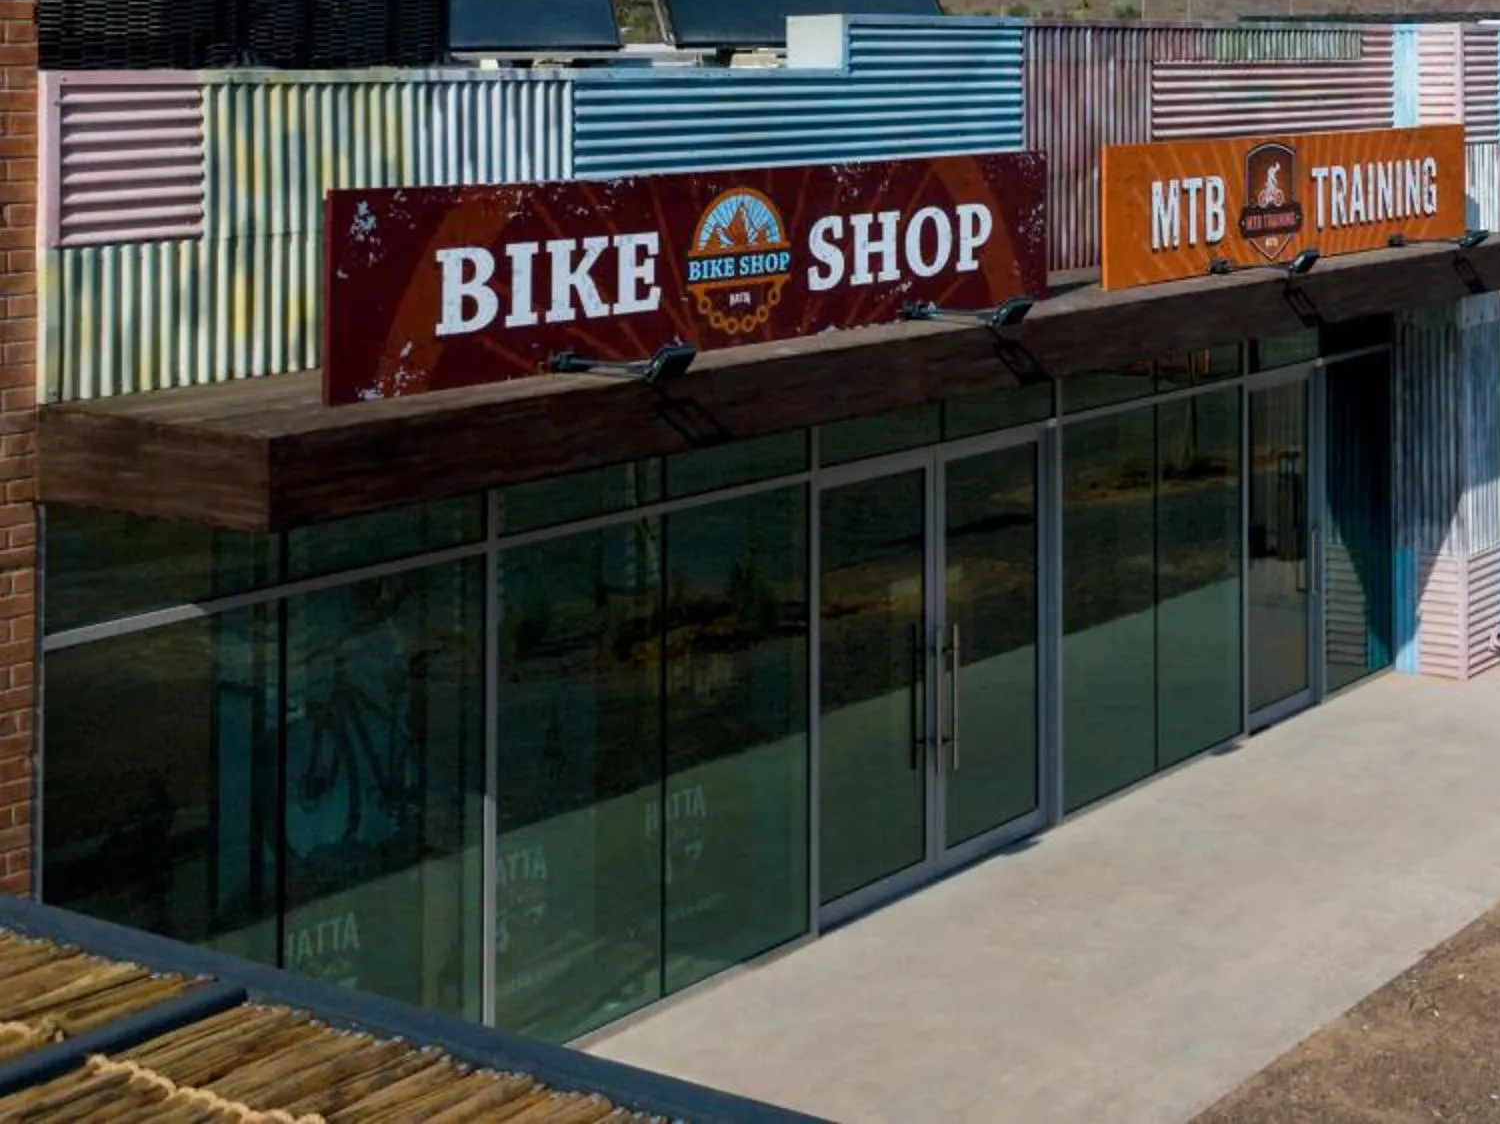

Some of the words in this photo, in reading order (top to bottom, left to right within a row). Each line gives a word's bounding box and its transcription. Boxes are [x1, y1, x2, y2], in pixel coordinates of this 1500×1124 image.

[1151, 175, 1227, 250] MTB
[1311, 157, 1438, 230] TRAINING
[435, 230, 662, 337] BIKE
[807, 202, 993, 292] SHOP
[687, 257, 736, 282] BIKE
[738, 251, 792, 277] SHOP
